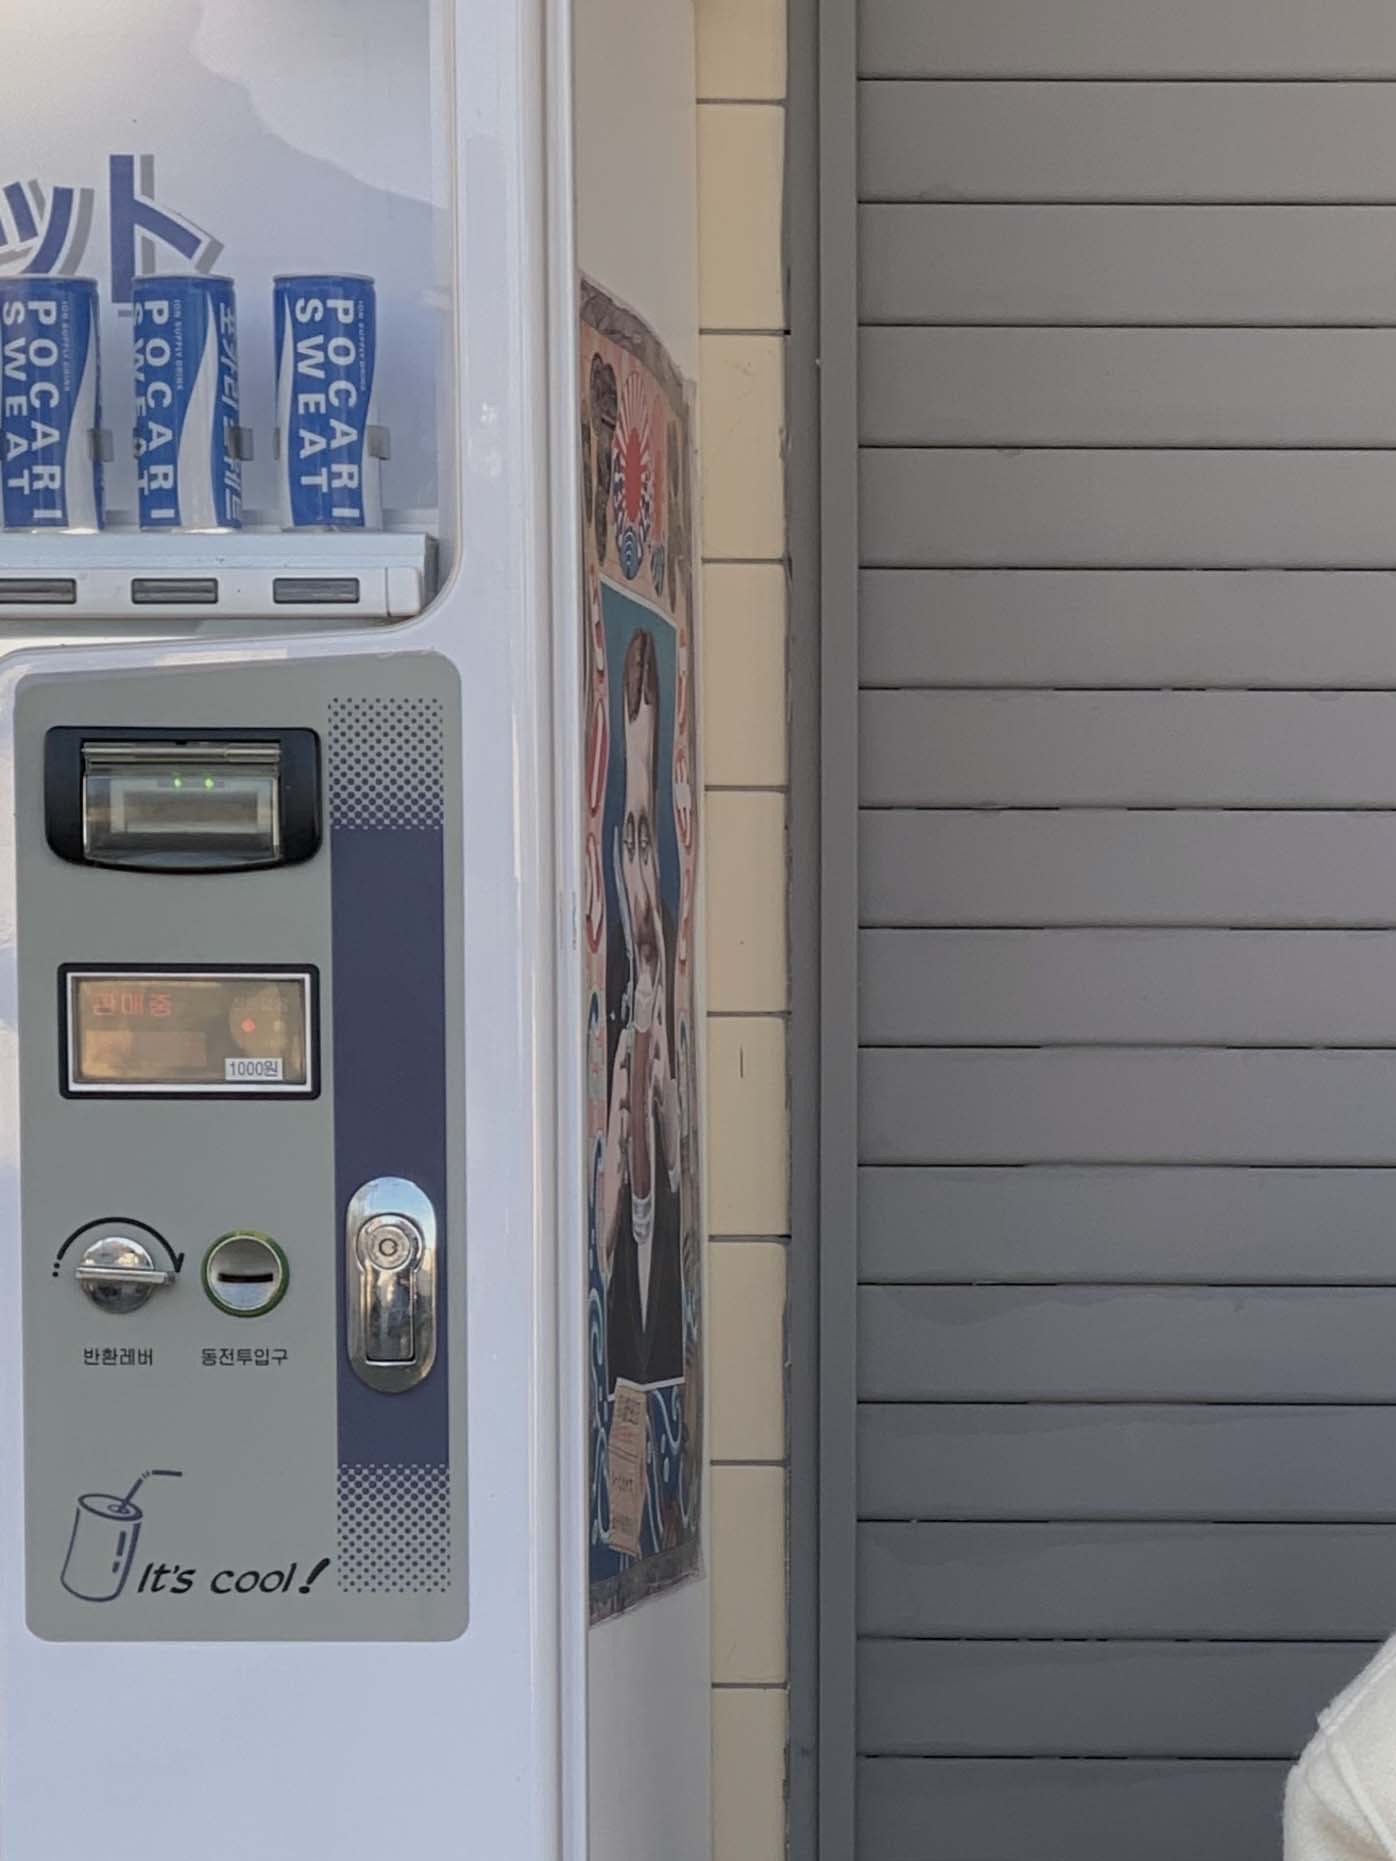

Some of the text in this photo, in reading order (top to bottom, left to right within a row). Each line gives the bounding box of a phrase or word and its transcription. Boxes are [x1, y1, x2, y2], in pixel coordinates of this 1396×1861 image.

[3, 302, 29, 495] SWEAT
[27, 301, 62, 519] POCARI
[144, 300, 175, 519] POCARI
[295, 298, 328, 493] SWEAT
[326, 299, 360, 519] POCARI
[229, 1060, 278, 1078] 1000원
[83, 1347, 153, 1366] 반환레버
[201, 1347, 289, 1367] 동전투입구
[137, 1557, 331, 1595] It's cool!
